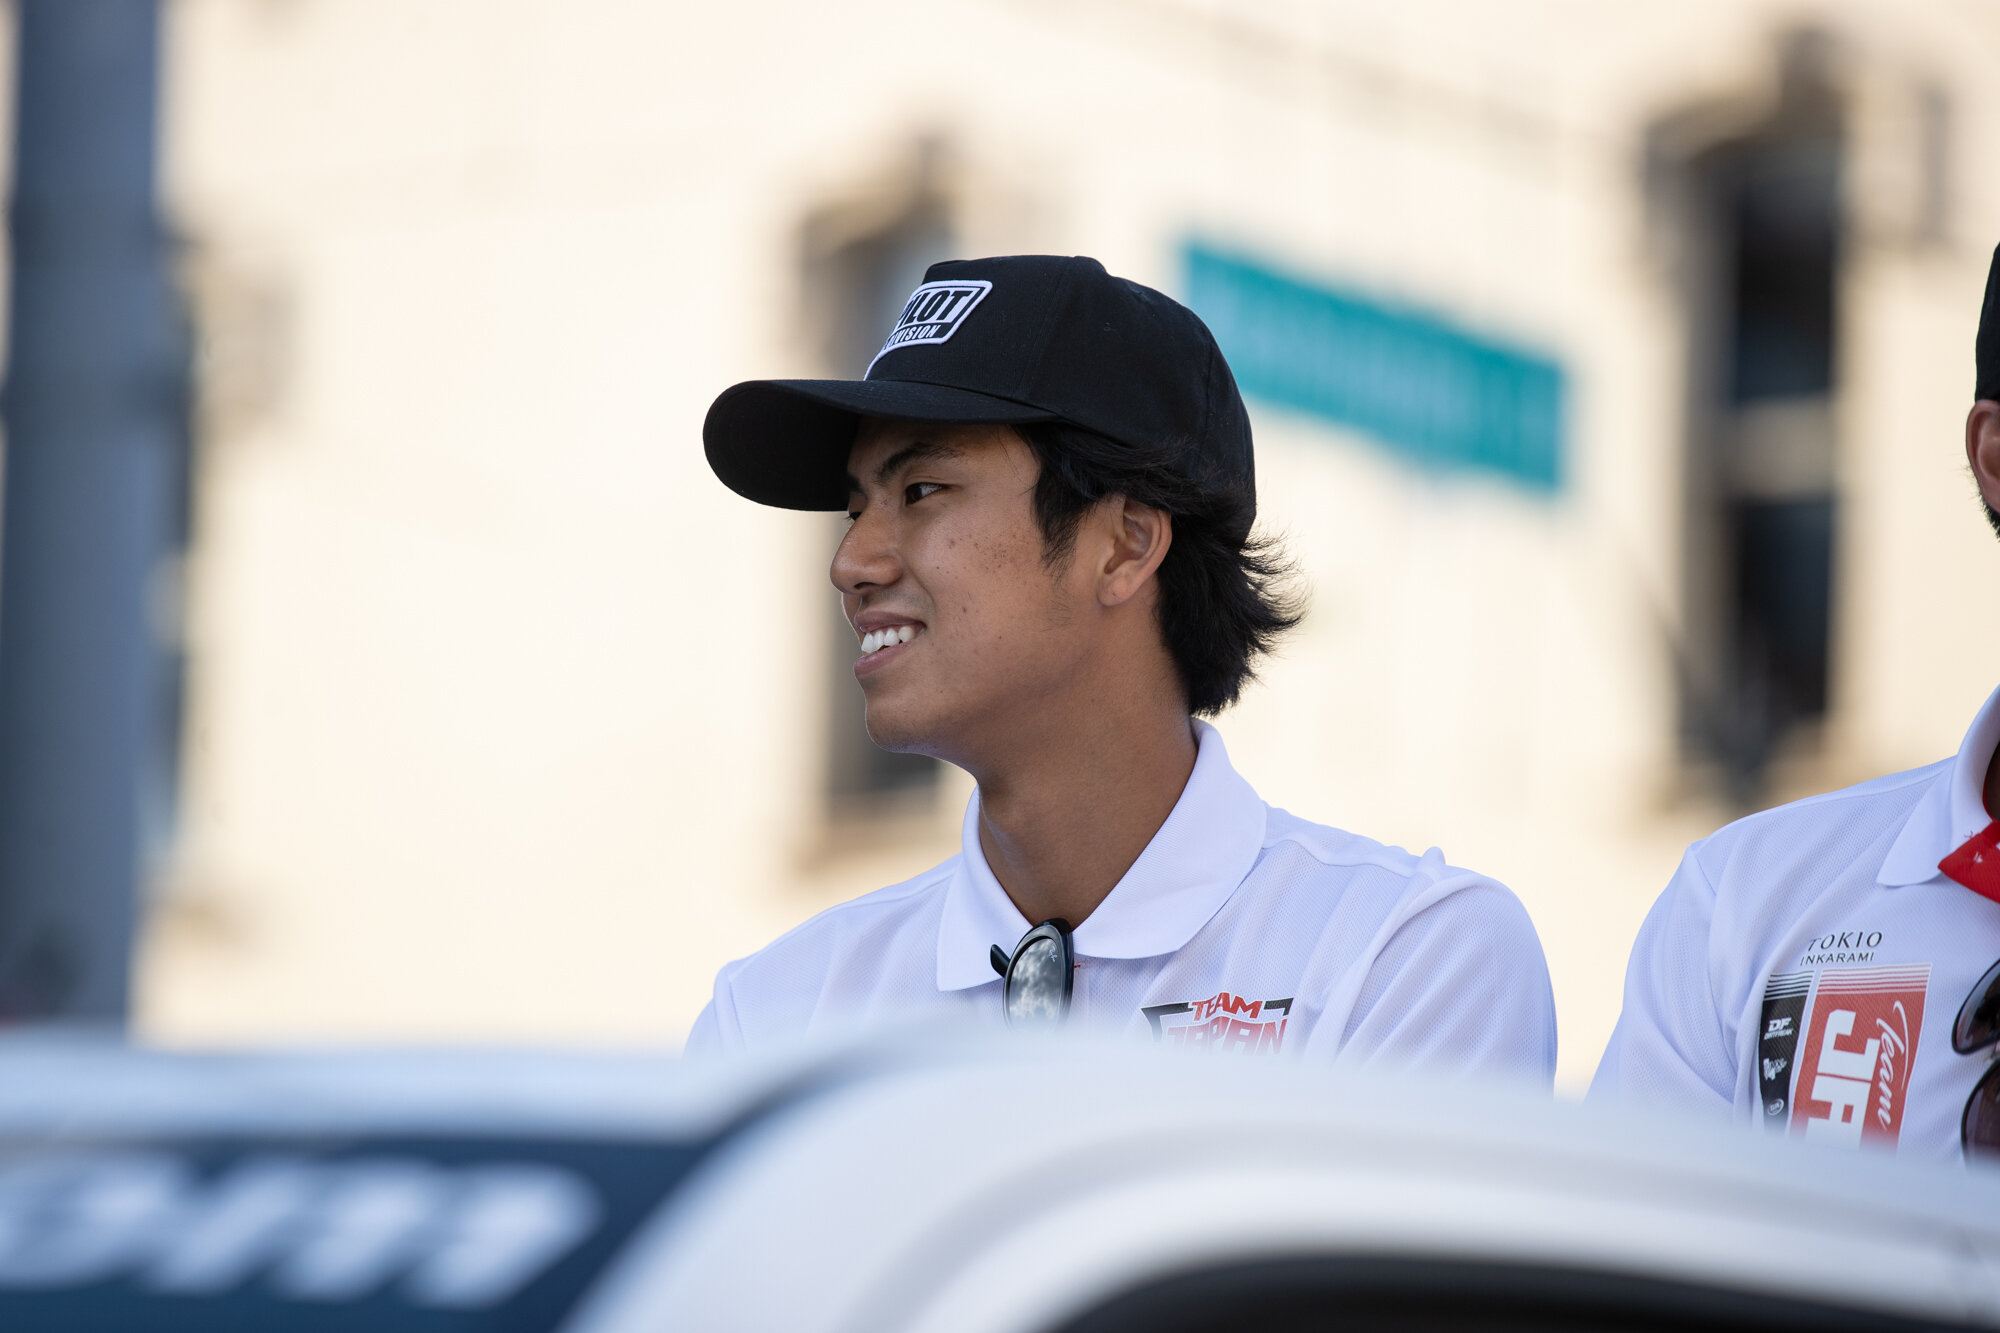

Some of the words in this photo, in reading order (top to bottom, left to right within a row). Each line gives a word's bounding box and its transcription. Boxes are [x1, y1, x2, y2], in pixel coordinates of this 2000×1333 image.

[1807, 931, 1883, 952] TOKIO
[1800, 952, 1875, 967] INKARAMI
[1191, 992, 1263, 1022] TEAM
[1167, 1016, 1288, 1056] JAPAN
[1768, 1017, 1792, 1032] DF
[1875, 1000, 1909, 1131] Team
